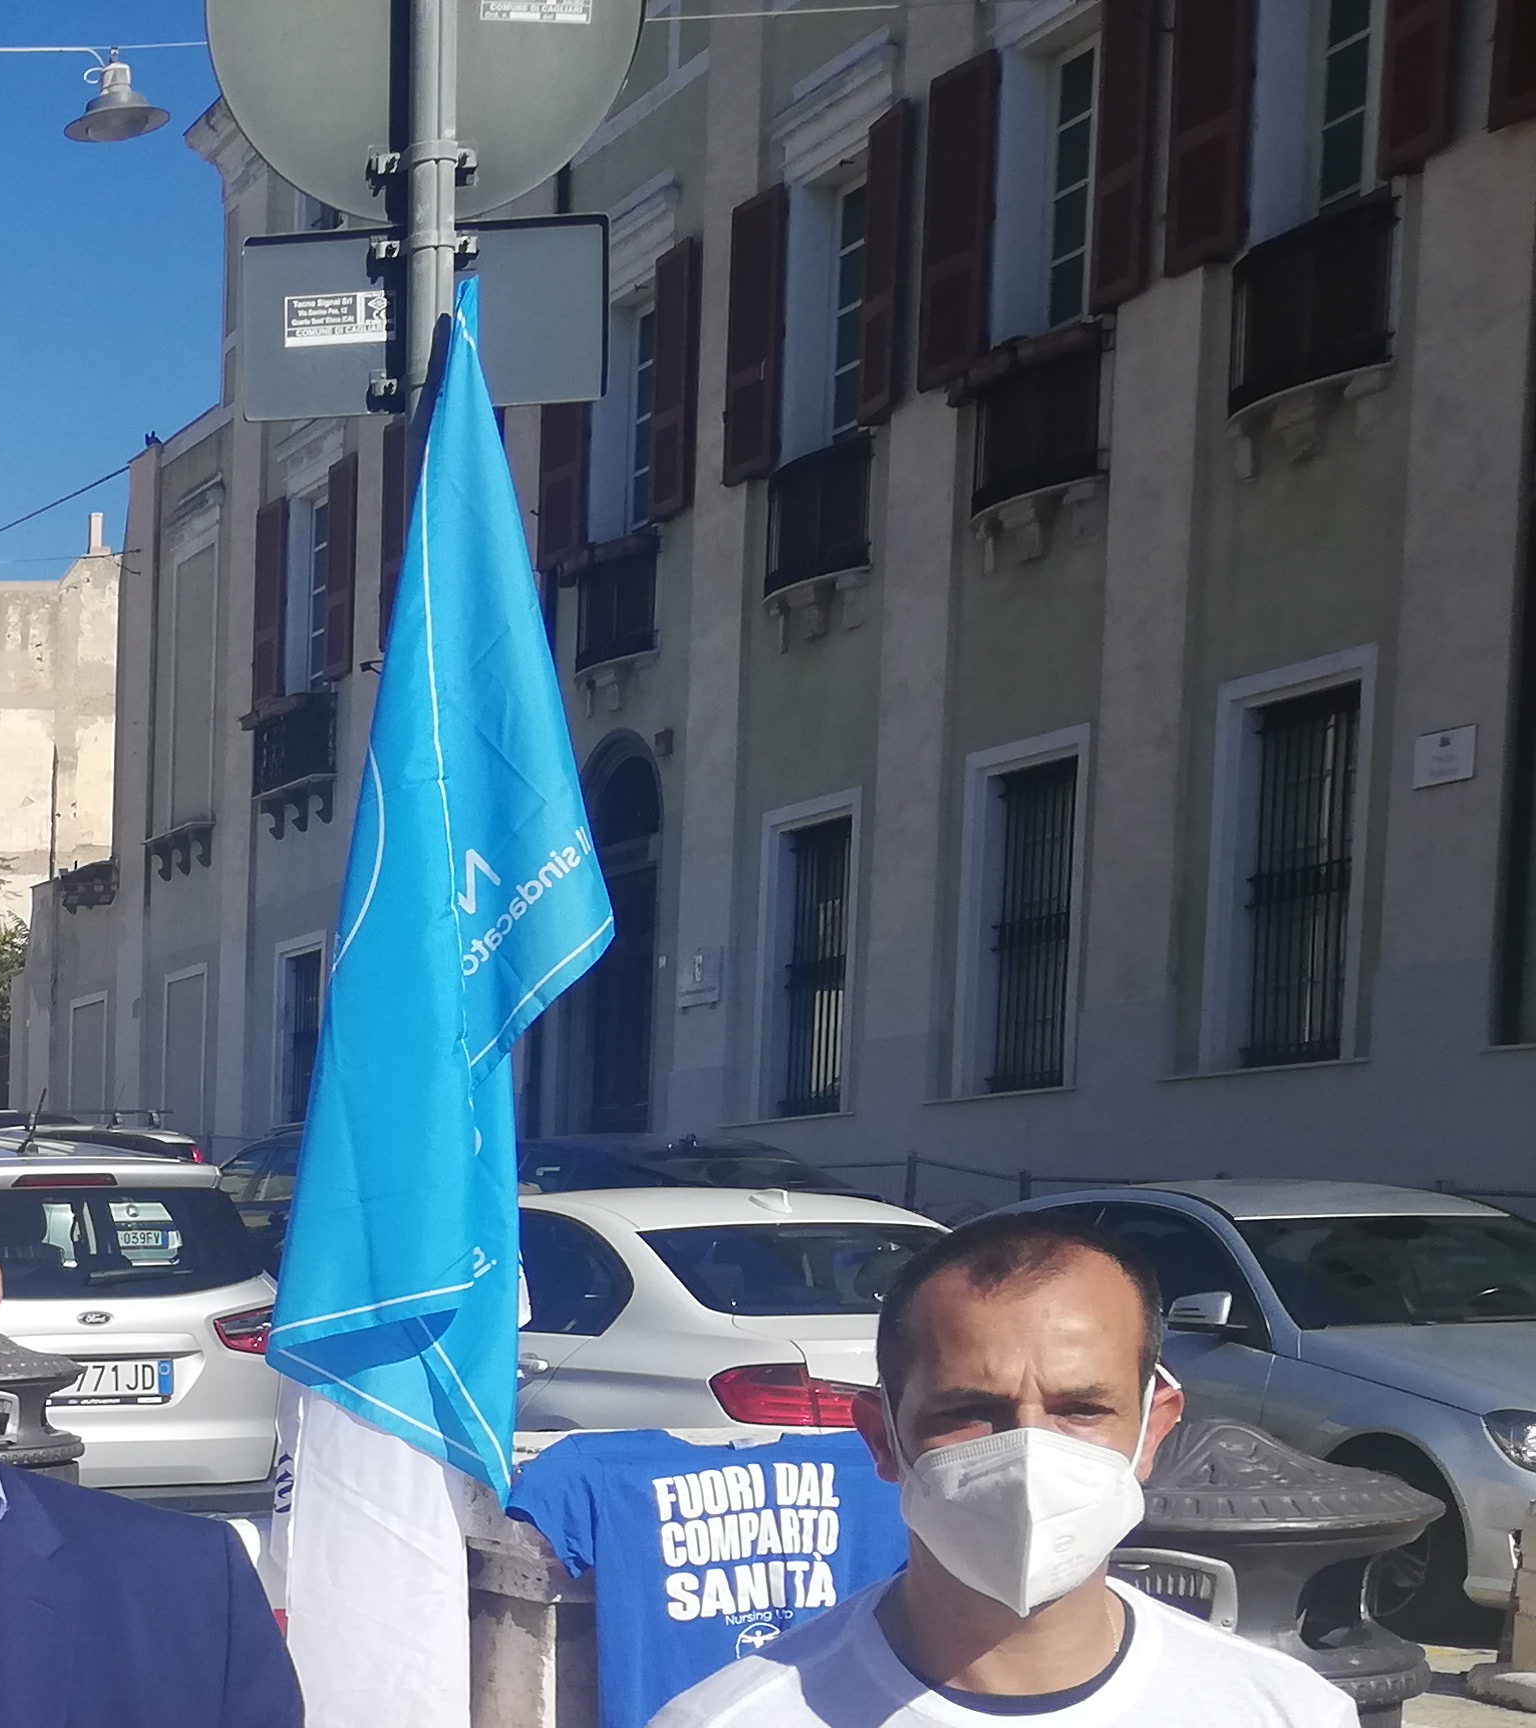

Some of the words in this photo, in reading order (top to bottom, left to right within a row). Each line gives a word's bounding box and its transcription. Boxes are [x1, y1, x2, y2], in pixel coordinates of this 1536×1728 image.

[490, 3, 528, 12] COMUNE
[530, 4, 540, 12] DI
[541, 5, 584, 14] CAGLIARI
[652, 1463, 765, 1521] FUORI
[772, 1462, 840, 1507] DAL
[661, 1508, 839, 1568] COMPARTO
[665, 1551, 837, 1621] SANITÀ
[725, 1609, 772, 1626] Nursing
